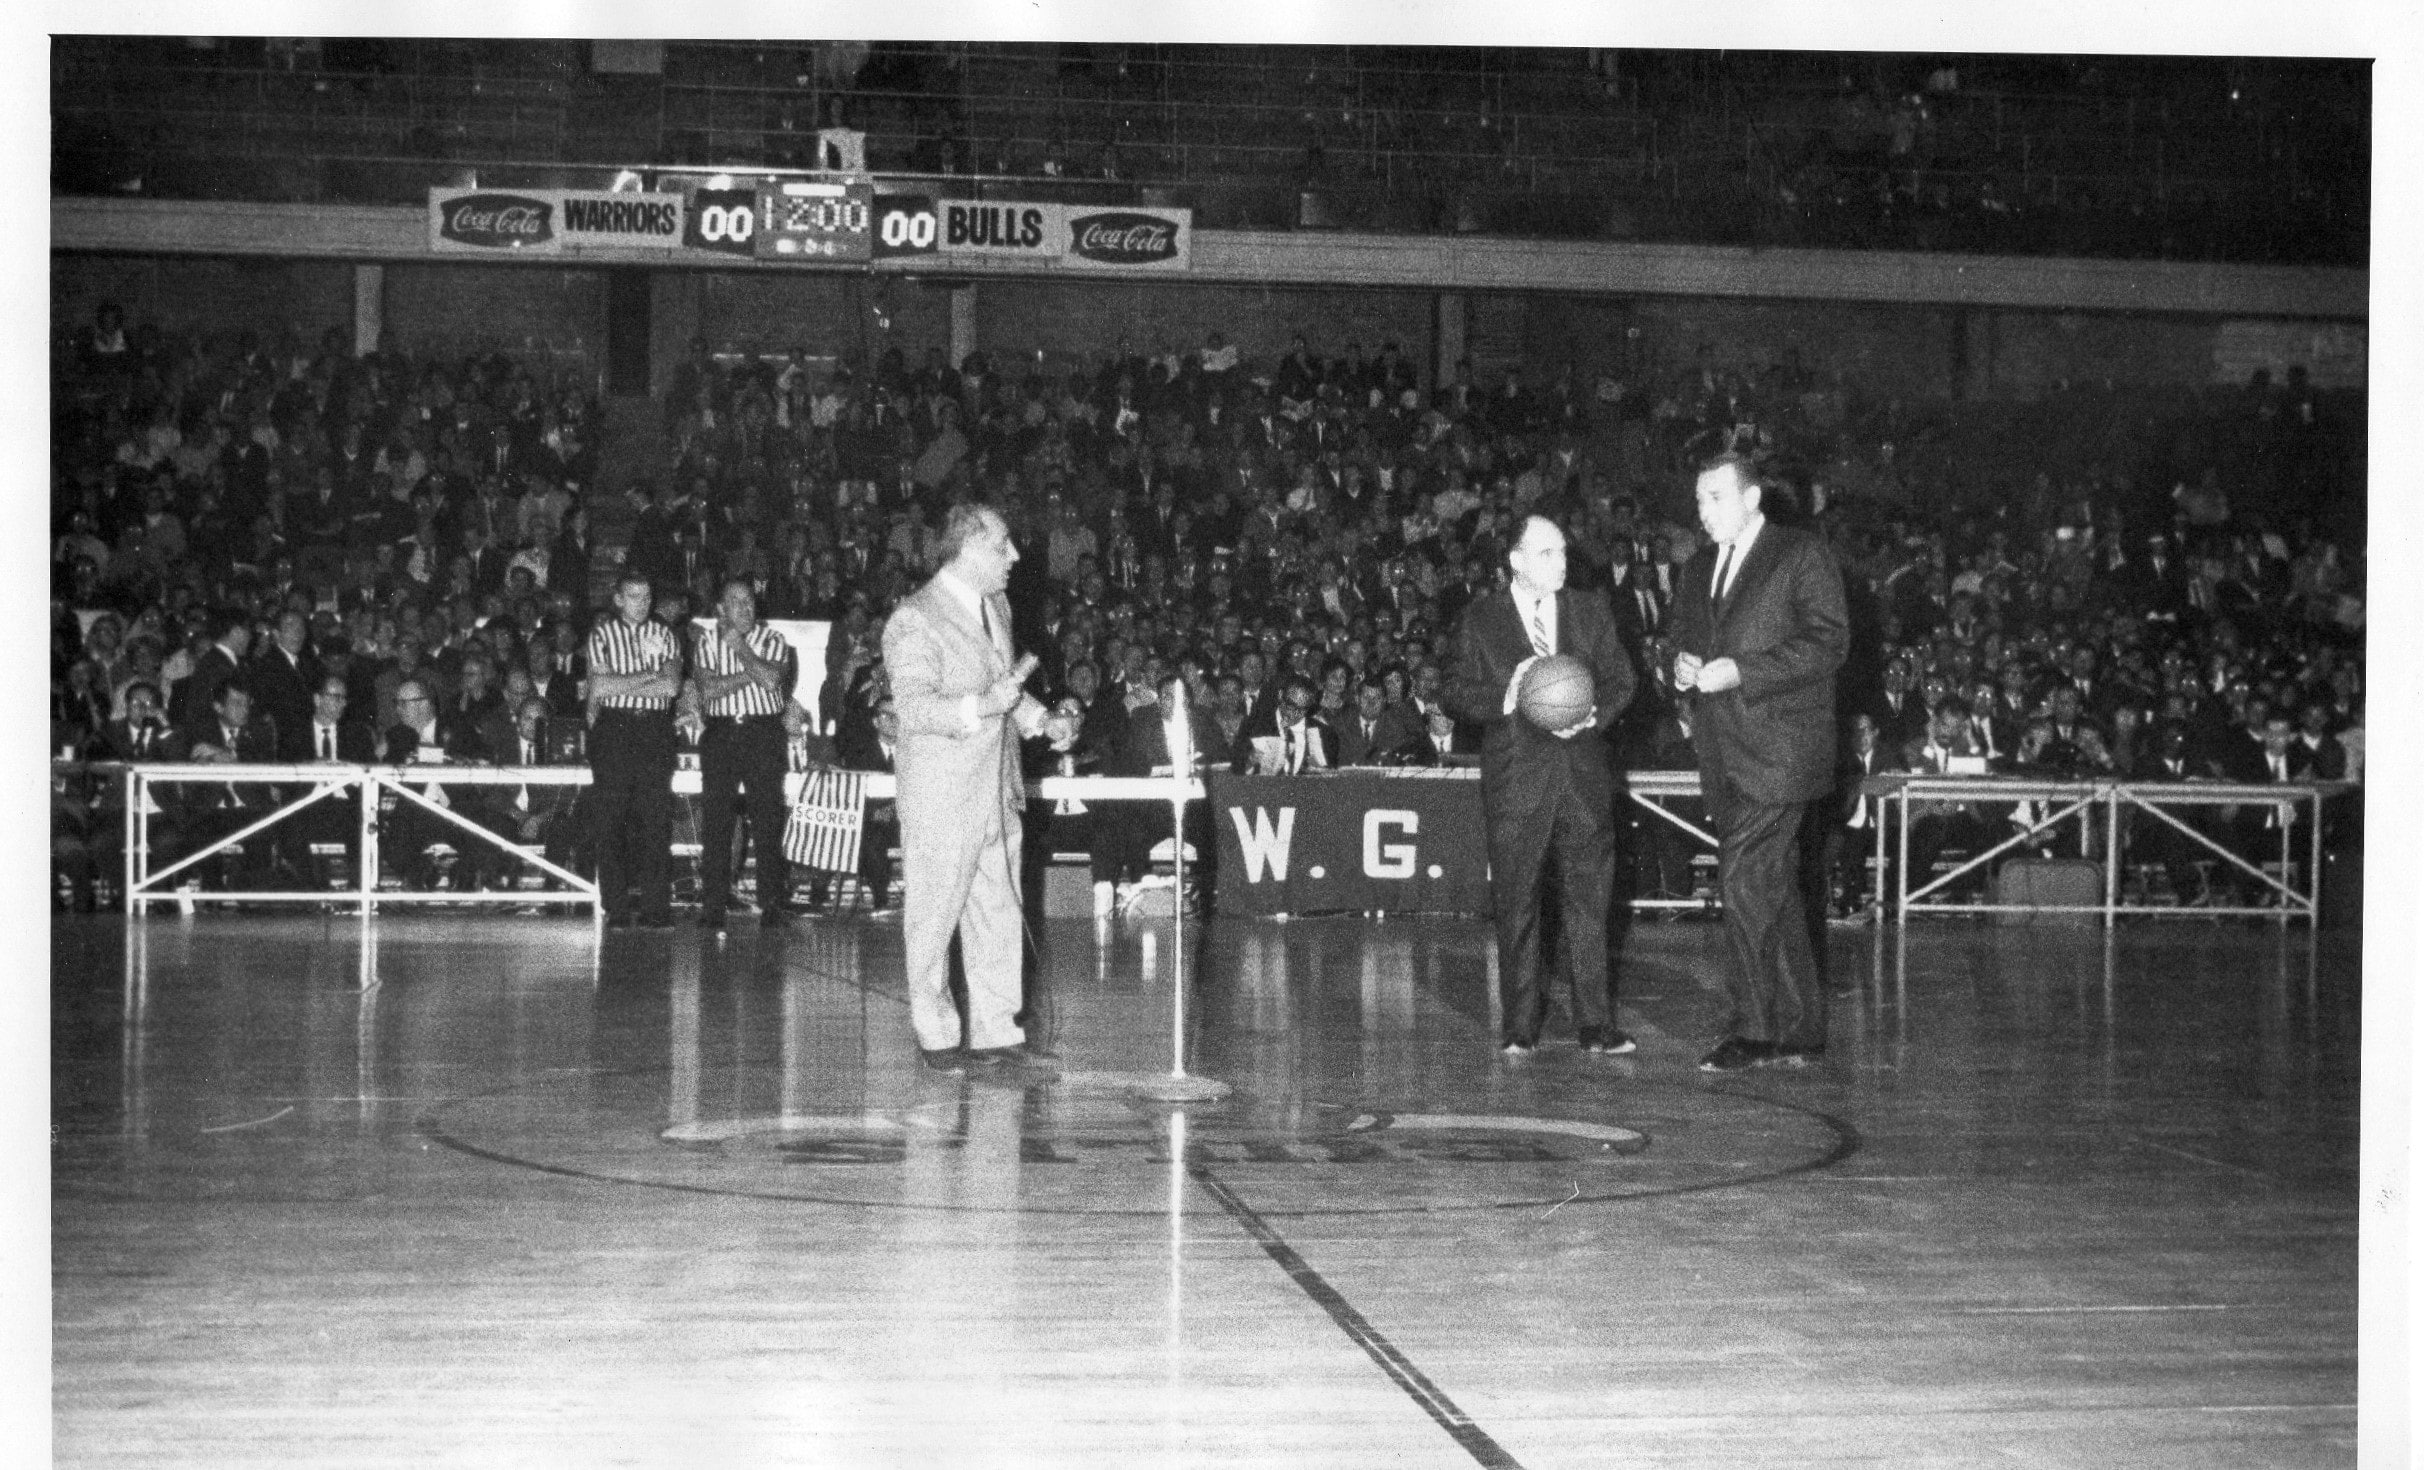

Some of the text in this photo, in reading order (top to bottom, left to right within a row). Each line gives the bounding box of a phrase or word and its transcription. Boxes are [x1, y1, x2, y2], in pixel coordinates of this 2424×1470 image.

[564, 199, 676, 235] WARRIORS
[701, 205, 752, 242] 00
[764, 195, 868, 233] 12:00
[881, 210, 936, 248] 00
[947, 205, 1043, 248] BULLS
[795, 804, 857, 826] SCORER
